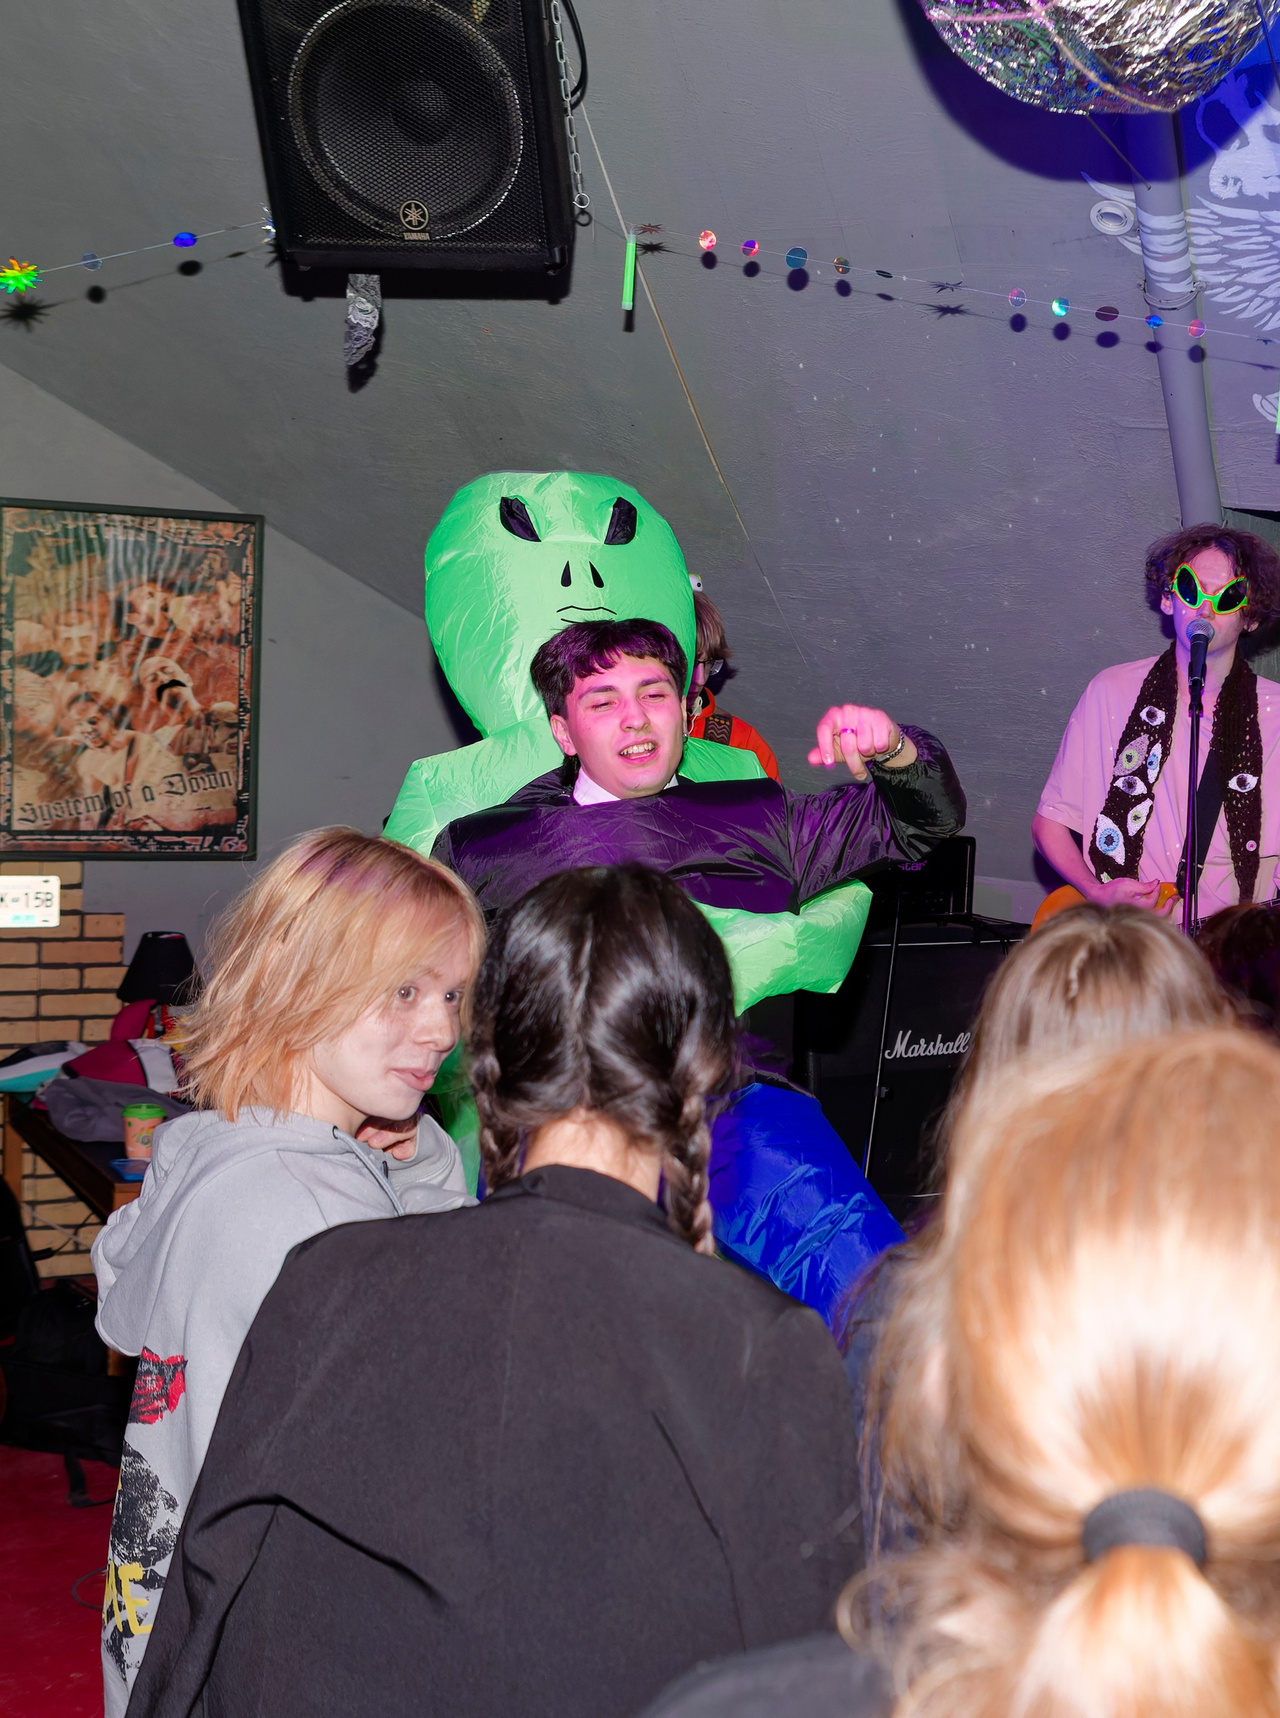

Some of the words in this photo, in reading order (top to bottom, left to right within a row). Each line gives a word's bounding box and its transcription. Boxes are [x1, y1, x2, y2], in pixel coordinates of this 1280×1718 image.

[16, 793, 106, 826] System
[111, 782, 134, 810] of
[142, 784, 155, 803] a
[159, 769, 234, 796] Down
[884, 1030, 971, 1060] Marshall
